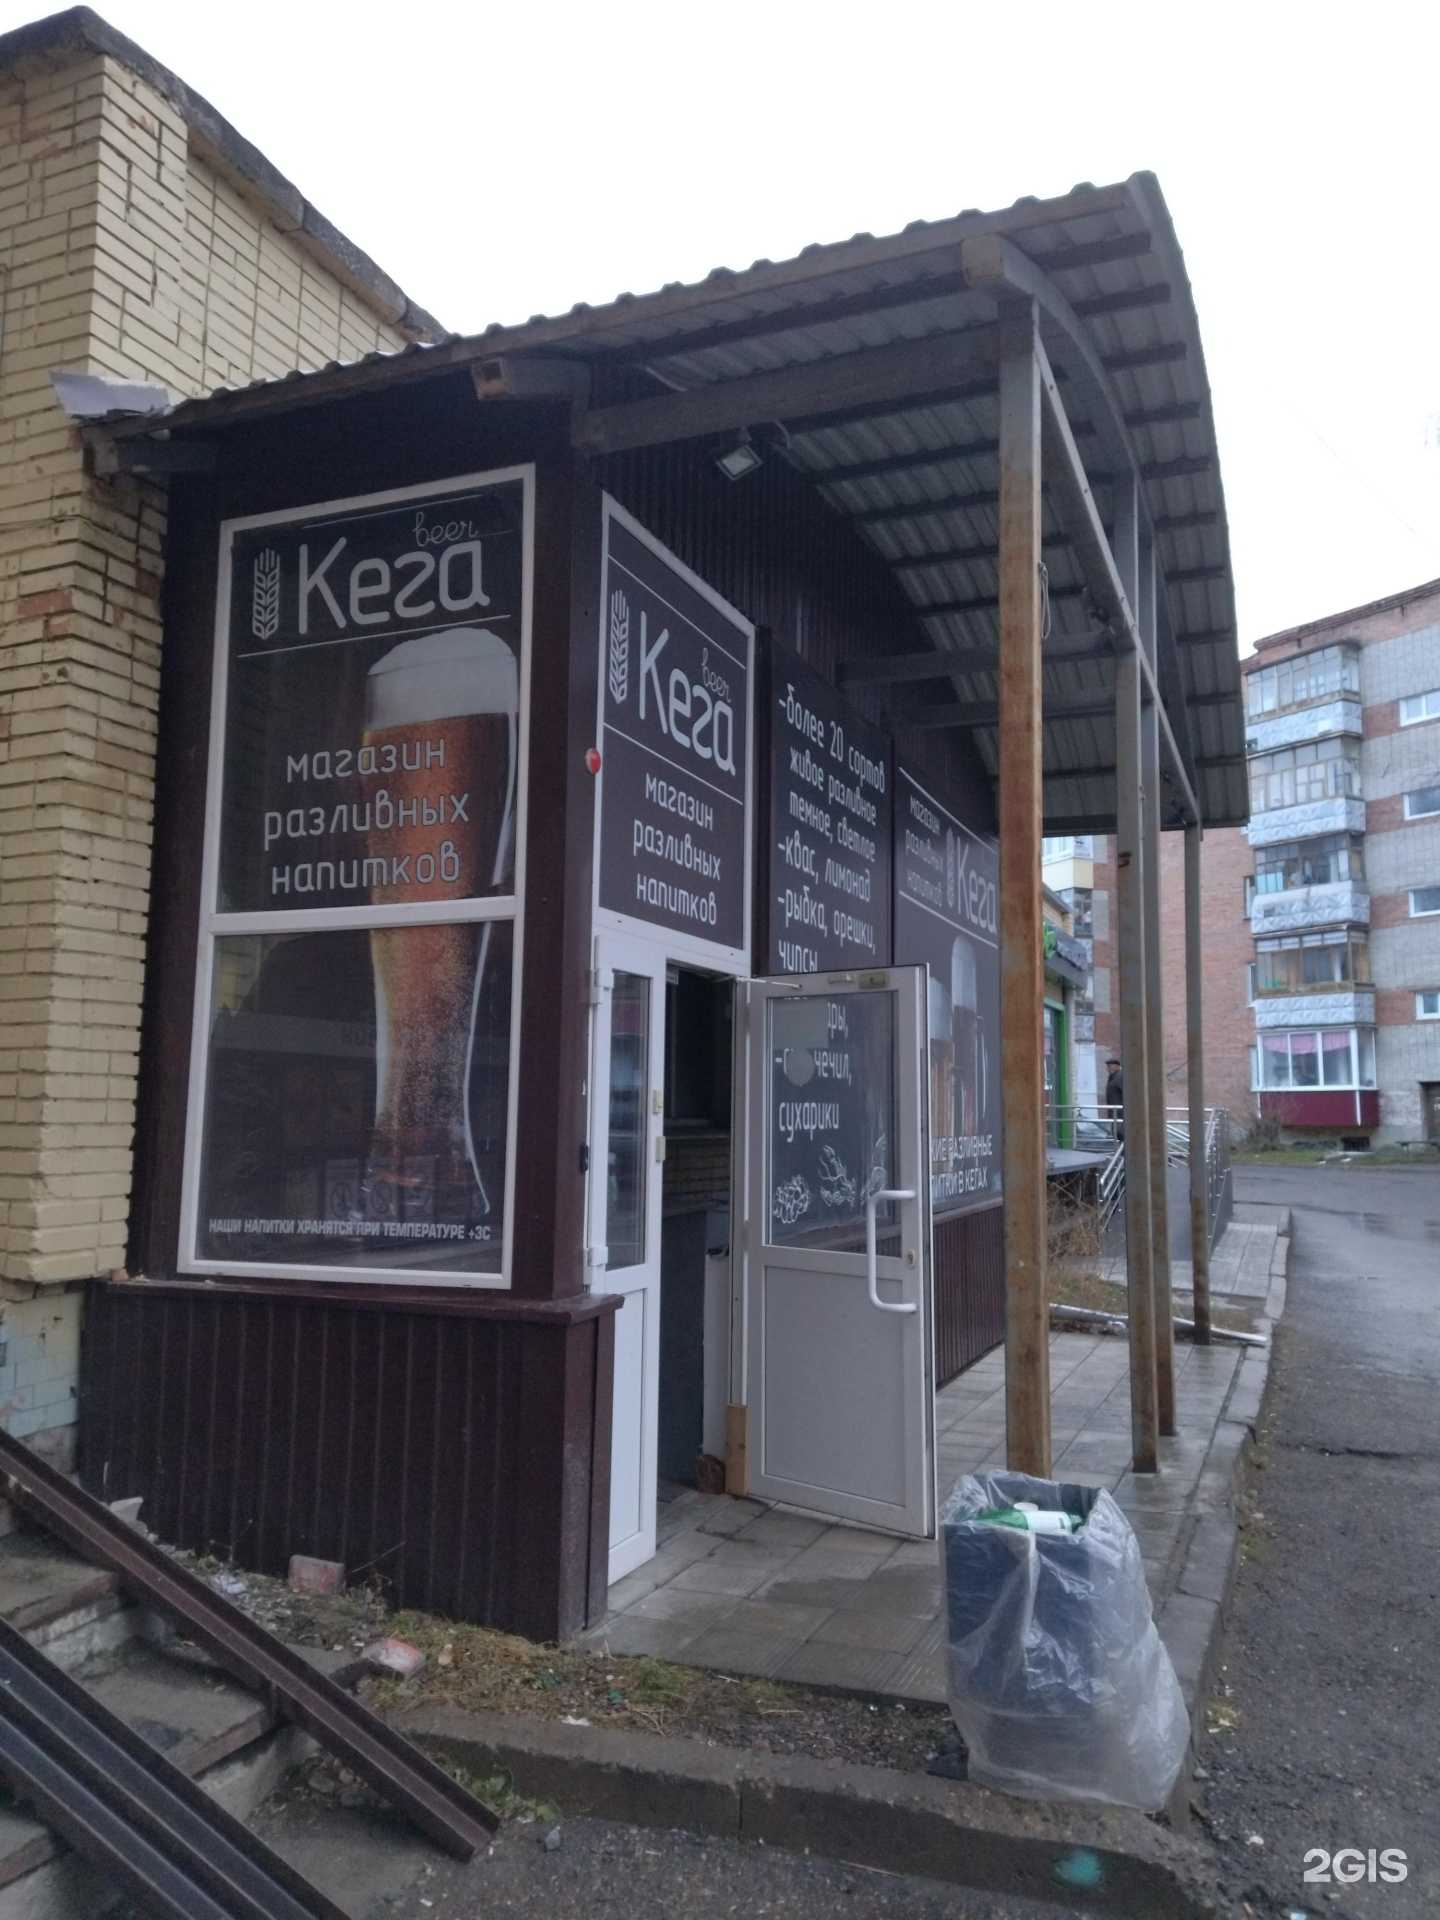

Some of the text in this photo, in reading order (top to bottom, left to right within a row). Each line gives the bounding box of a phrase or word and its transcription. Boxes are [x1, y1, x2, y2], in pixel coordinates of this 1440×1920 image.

[412, 512, 479, 547] beer
[299, 536, 490, 634] Кега
[639, 610, 736, 777] Кега
[702, 648, 731, 703] beer
[286, 737, 445, 783] магазин
[778, 683, 885, 794] -более 20 сортов
[645, 772, 714, 832] магазин
[790, 747, 877, 826] живое разливное
[263, 789, 470, 851] разливных
[837, 820, 876, 862] светлое
[271, 840, 461, 895] напитков
[633, 819, 721, 881] разливных
[636, 873, 717, 926] напитков
[825, 858, 871, 902] лимонад
[957, 836, 998, 934] Кега
[778, 1101, 840, 1143] сухарики
[209, 1219, 242, 1233] НАШИ
[244, 1219, 294, 1234] НАПИТКИ
[383, 1222, 464, 1240] ТЕМПЕРАТУРЕ
